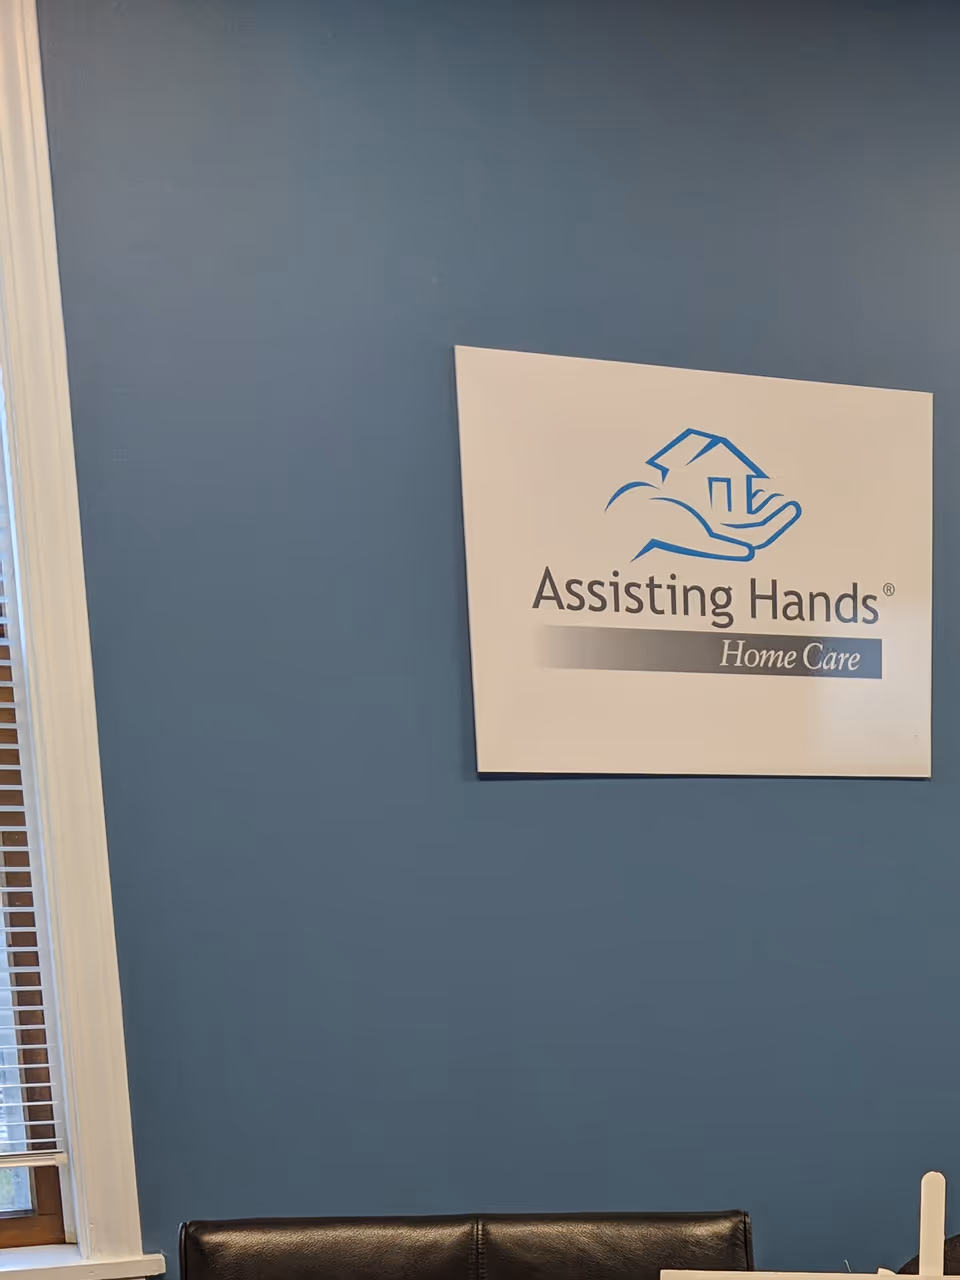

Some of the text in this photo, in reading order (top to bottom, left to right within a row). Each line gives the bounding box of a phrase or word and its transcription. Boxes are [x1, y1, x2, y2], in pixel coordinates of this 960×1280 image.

[532, 565, 734, 629] Assisting
[719, 639, 860, 671] Home Care
